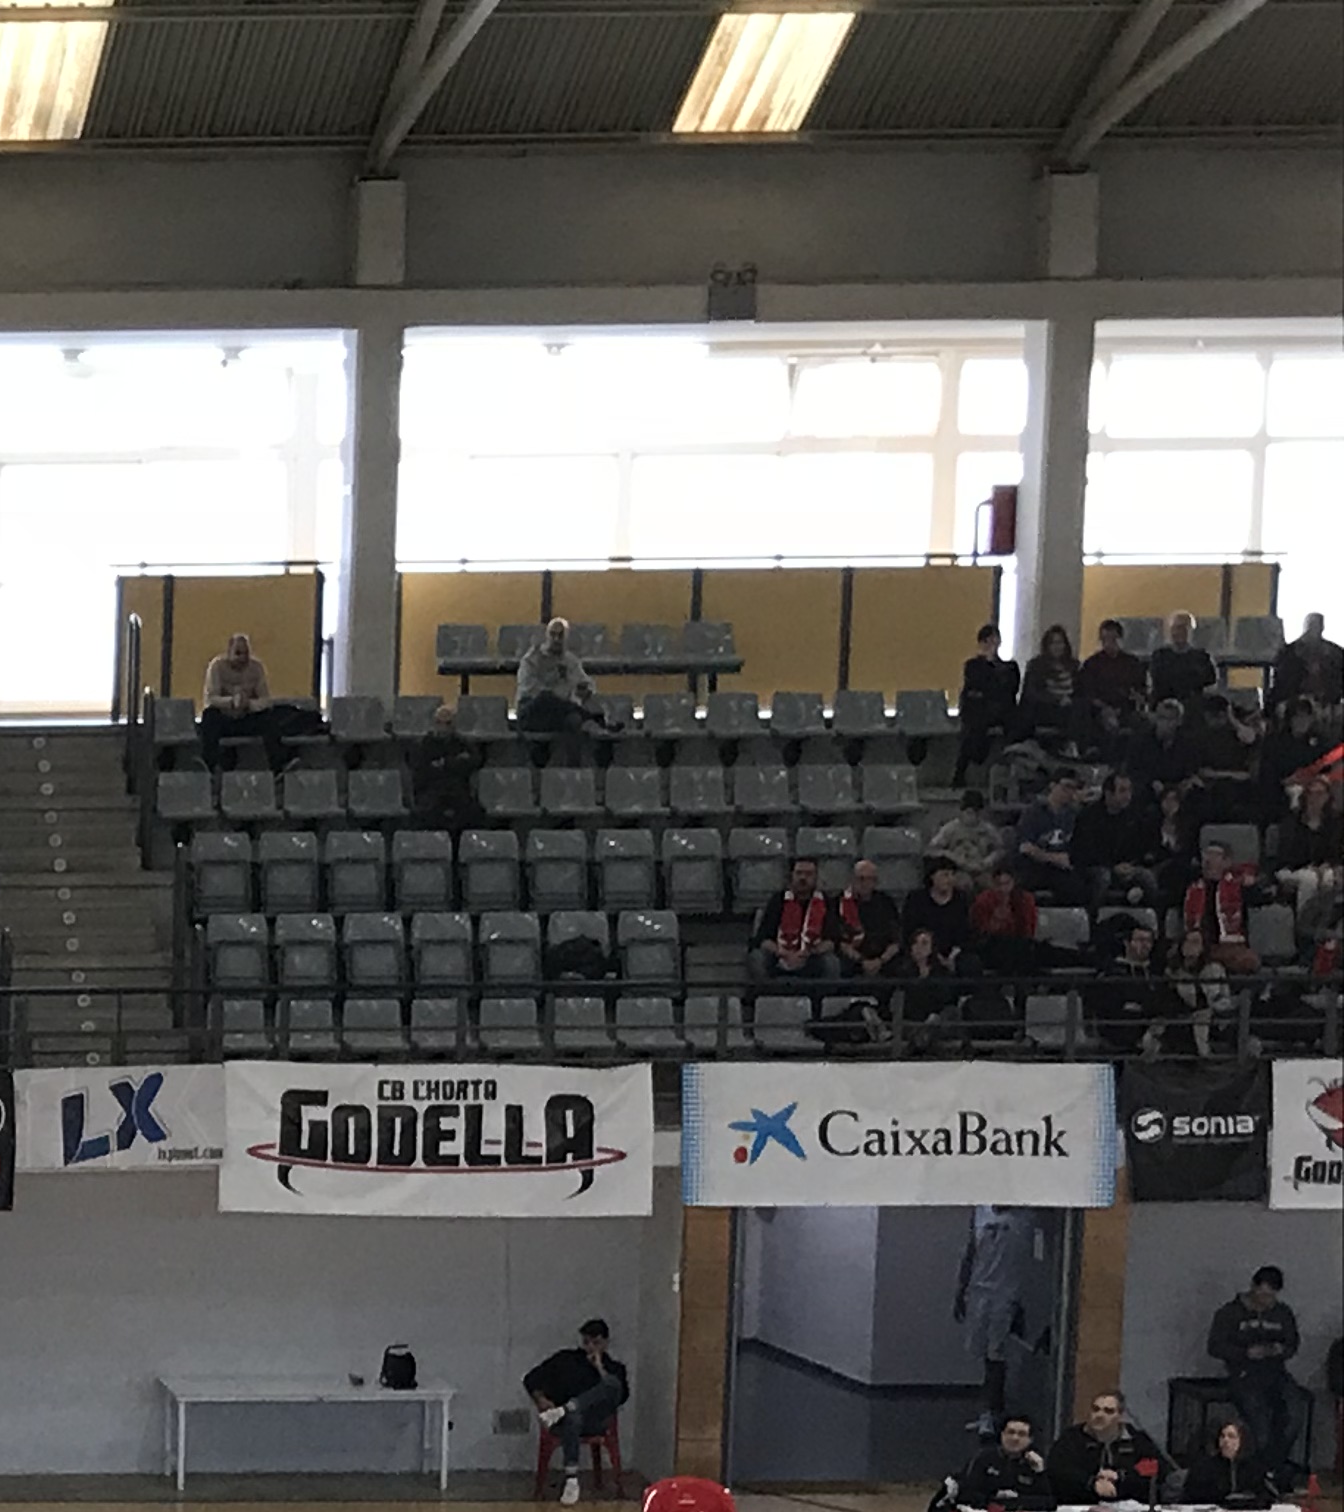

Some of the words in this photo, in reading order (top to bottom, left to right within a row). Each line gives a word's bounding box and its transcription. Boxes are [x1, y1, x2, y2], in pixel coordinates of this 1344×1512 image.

[61, 1072, 167, 1166] LX
[377, 1079, 405, 1101] CB
[278, 1088, 595, 1180] GODELLA
[818, 1109, 1070, 1158] CaixaBank
